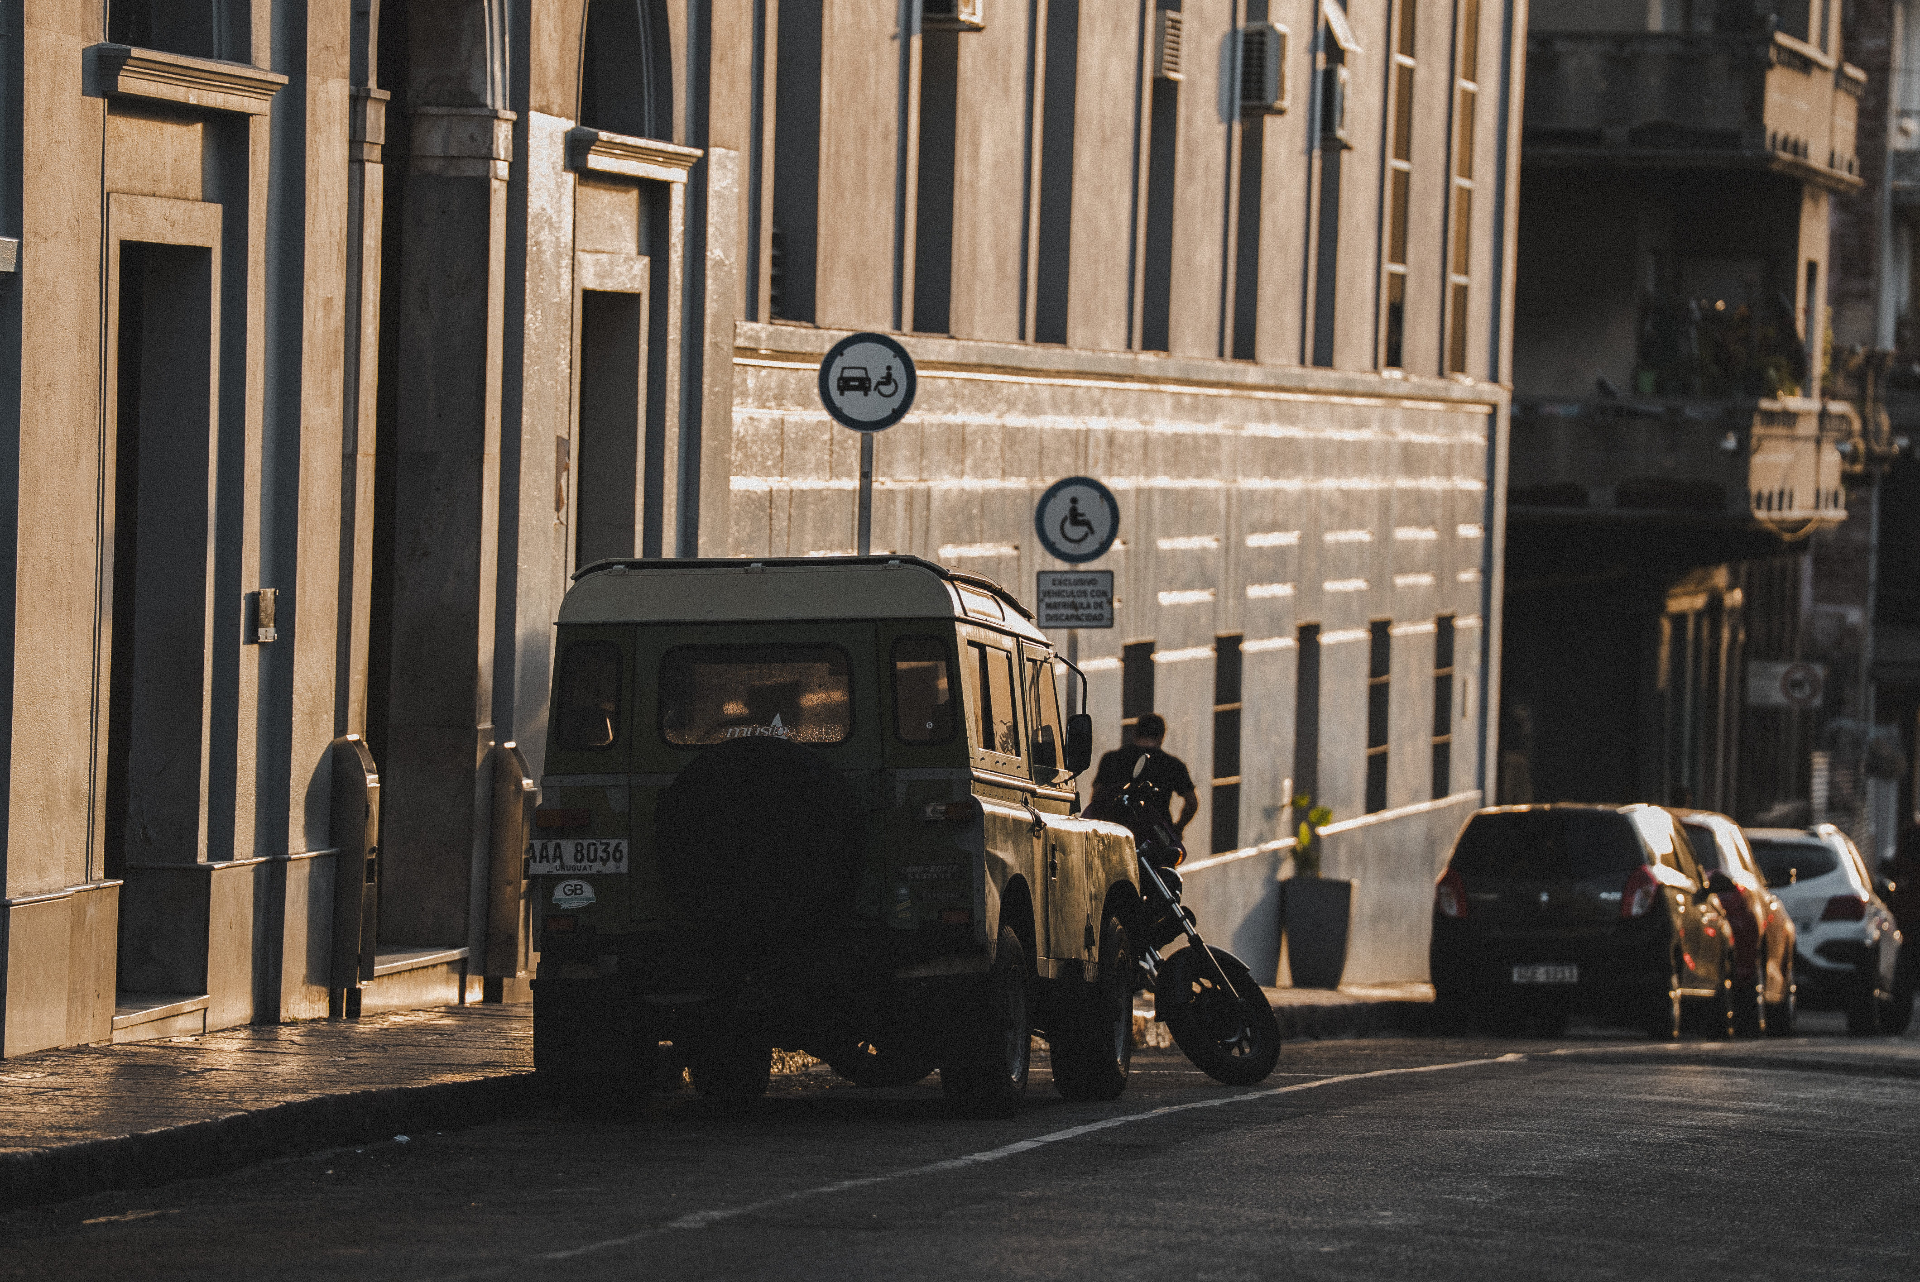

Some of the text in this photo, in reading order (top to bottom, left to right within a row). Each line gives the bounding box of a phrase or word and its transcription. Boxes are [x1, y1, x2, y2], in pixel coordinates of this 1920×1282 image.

[1052, 578, 1098, 586] EXCLUSIVO
[1090, 589, 1108, 598] CON
[1093, 601, 1103, 610] DE
[529, 842, 623, 864] AAA 8036
[555, 864, 593, 872] URUGUAY
[563, 883, 584, 896] GB
